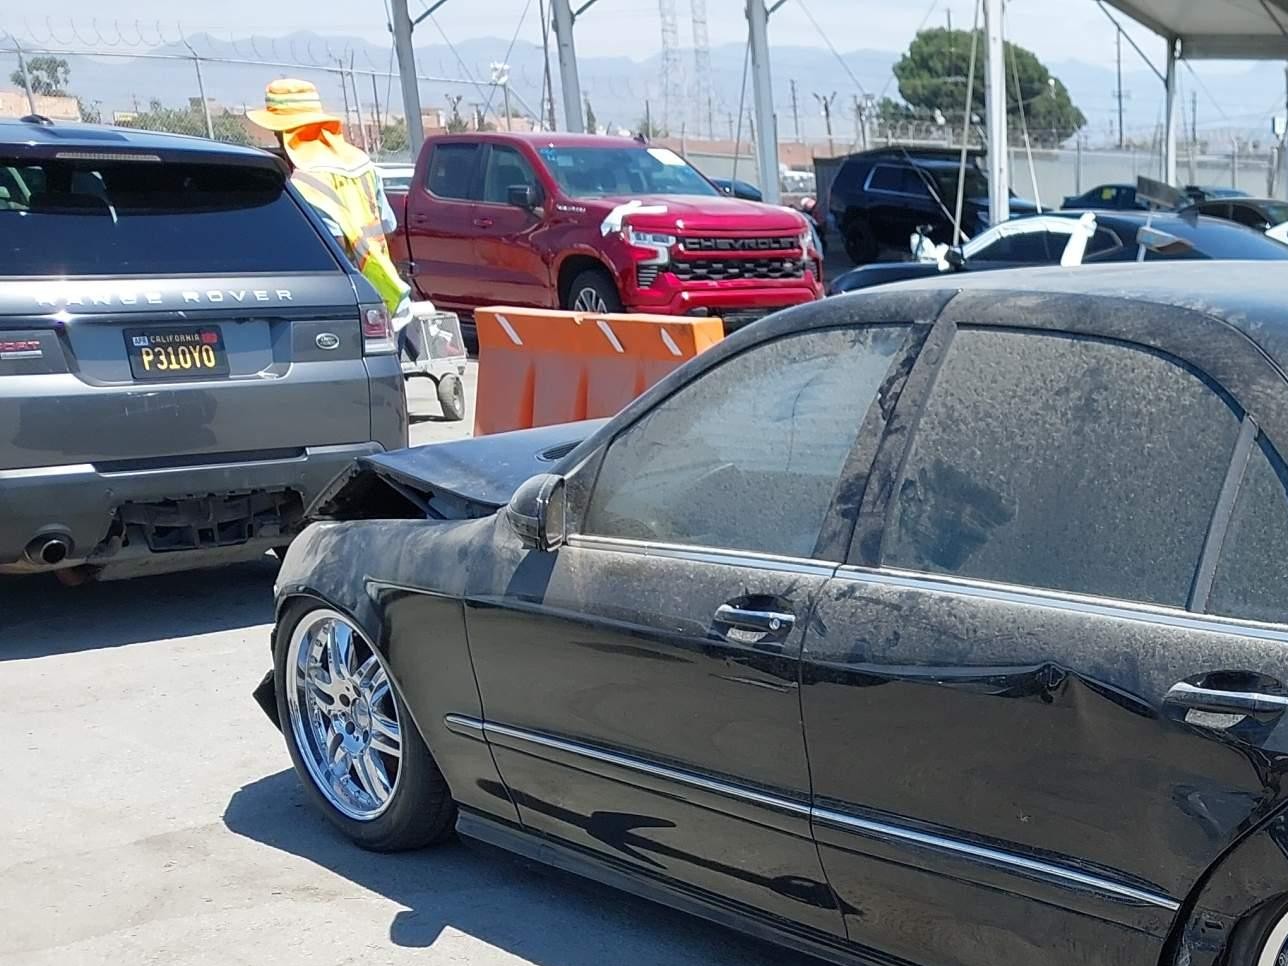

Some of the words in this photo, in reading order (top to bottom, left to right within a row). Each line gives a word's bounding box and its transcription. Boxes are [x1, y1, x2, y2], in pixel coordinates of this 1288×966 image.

[684, 238, 799, 250] CHEVROLET
[182, 290, 293, 303] ROVER
[150, 334, 200, 344] CALIFORNIA
[0, 341, 40, 350] ORT
